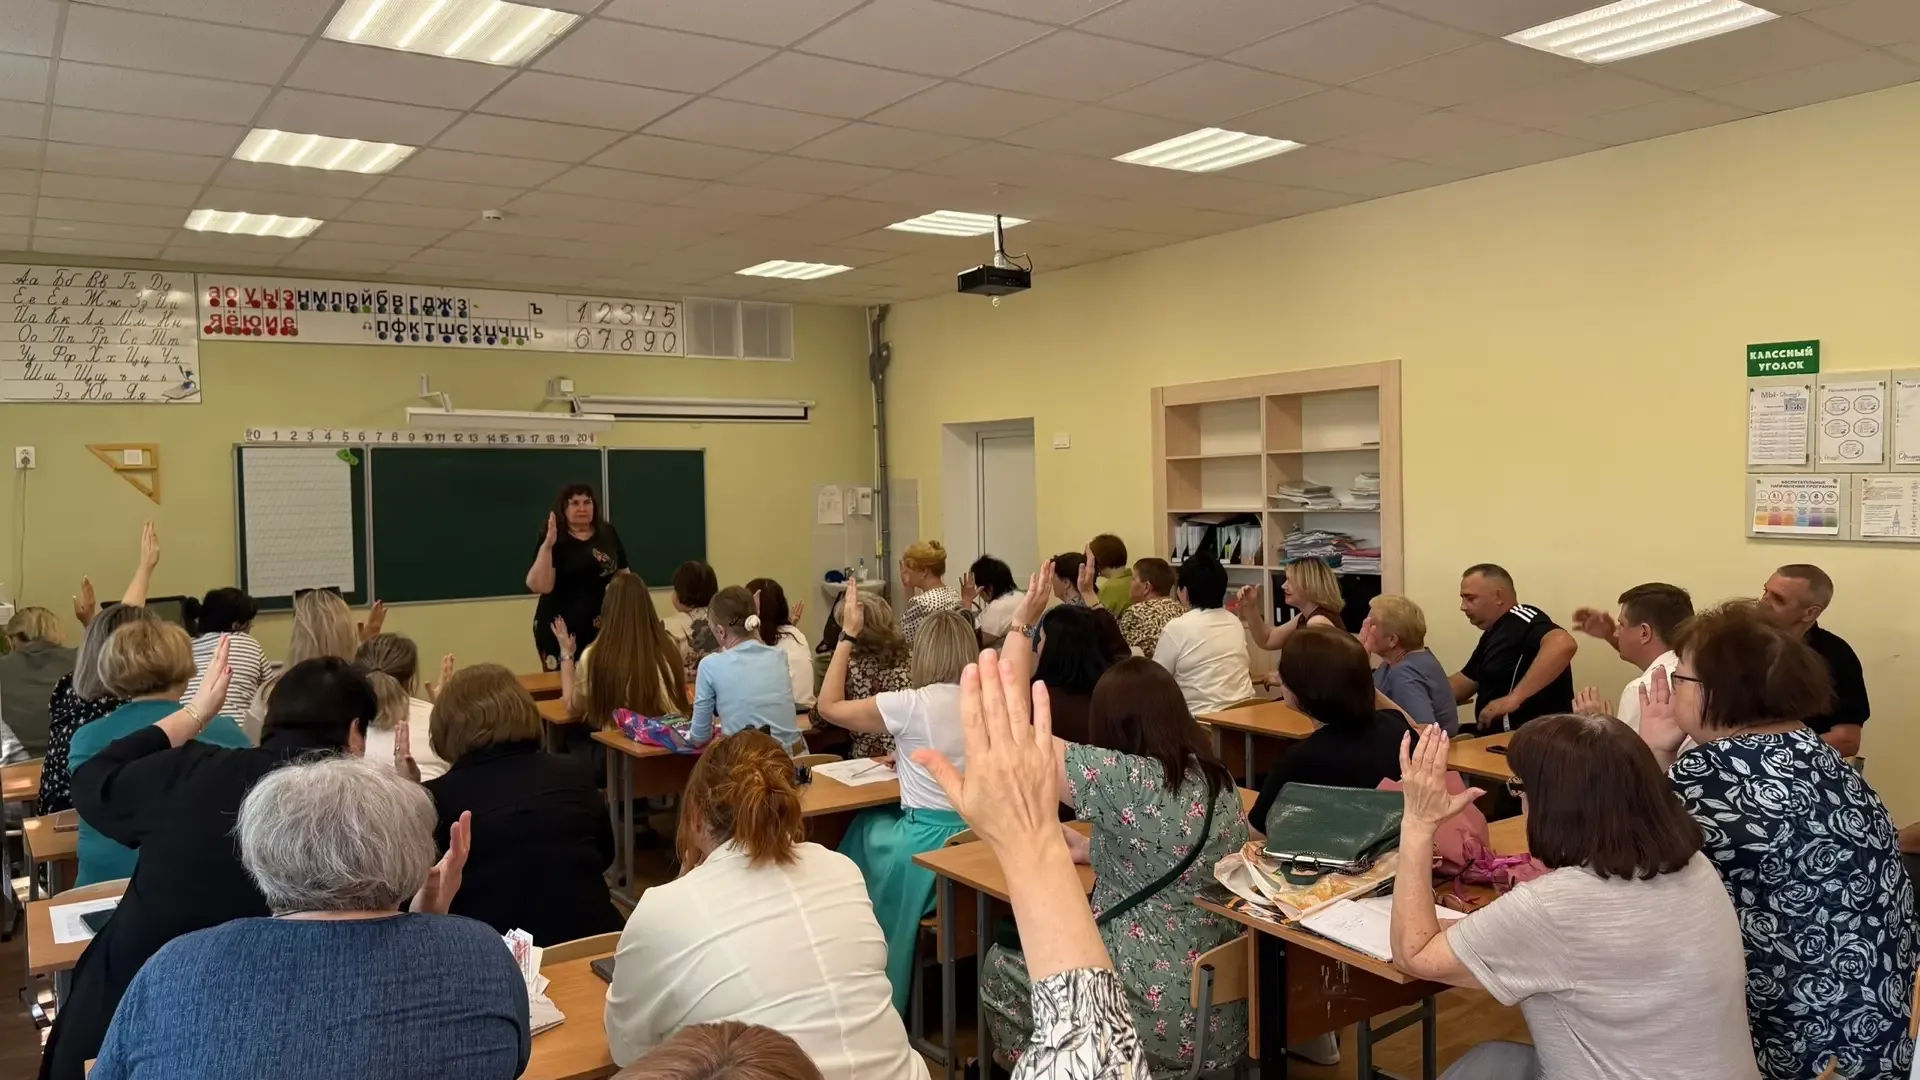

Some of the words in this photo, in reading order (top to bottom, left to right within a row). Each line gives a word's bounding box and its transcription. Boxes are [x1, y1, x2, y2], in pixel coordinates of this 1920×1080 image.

[13, 268, 39, 285] Аа
[53, 269, 82, 287] Бб
[86, 270, 109, 288] Вв
[117, 272, 136, 289] Гг
[13, 287, 36, 305] Ее
[80, 289, 121, 307] Жж
[45, 307, 70, 324] Кк
[77, 309, 104, 325] Лл
[112, 310, 146, 327] Мм
[157, 311, 181, 328] Нн
[577, 302, 590, 323] 1
[599, 303, 611, 324] 2
[618, 304, 634, 324] 3
[642, 306, 655, 325] 4
[662, 307, 676, 327] 5
[18, 324, 38, 343] Оо
[48, 326, 74, 343] Пп
[120, 329, 137, 344] Сс
[146, 329, 179, 345] Тт
[575, 328, 591, 349] 6
[599, 330, 613, 350] 7
[621, 330, 633, 350] 8
[643, 331, 656, 352] 9
[662, 333, 676, 353] 0
[17, 345, 36, 368] Уу
[50, 346, 76, 368] Фф
[86, 345, 116, 363] Хх
[125, 347, 150, 367] Цц
[162, 348, 180, 364] Чч
[1750, 346, 1813, 359] КЛАССНЫЙ
[1759, 361, 1804, 371] УГОЛОК
[53, 383, 70, 400] Ээ
[80, 382, 112, 400] Юю
[123, 383, 146, 400] Яя
[253, 430, 260, 439] 0
[273, 431, 278, 440] 1
[290, 431, 297, 440] 2
[307, 432, 314, 440] 3
[325, 432, 332, 441] 4
[343, 432, 349, 441] 5
[359, 432, 365, 441] 6
[376, 432, 382, 441] 7
[392, 432, 398, 441] 8
[409, 432, 415, 441] 9
